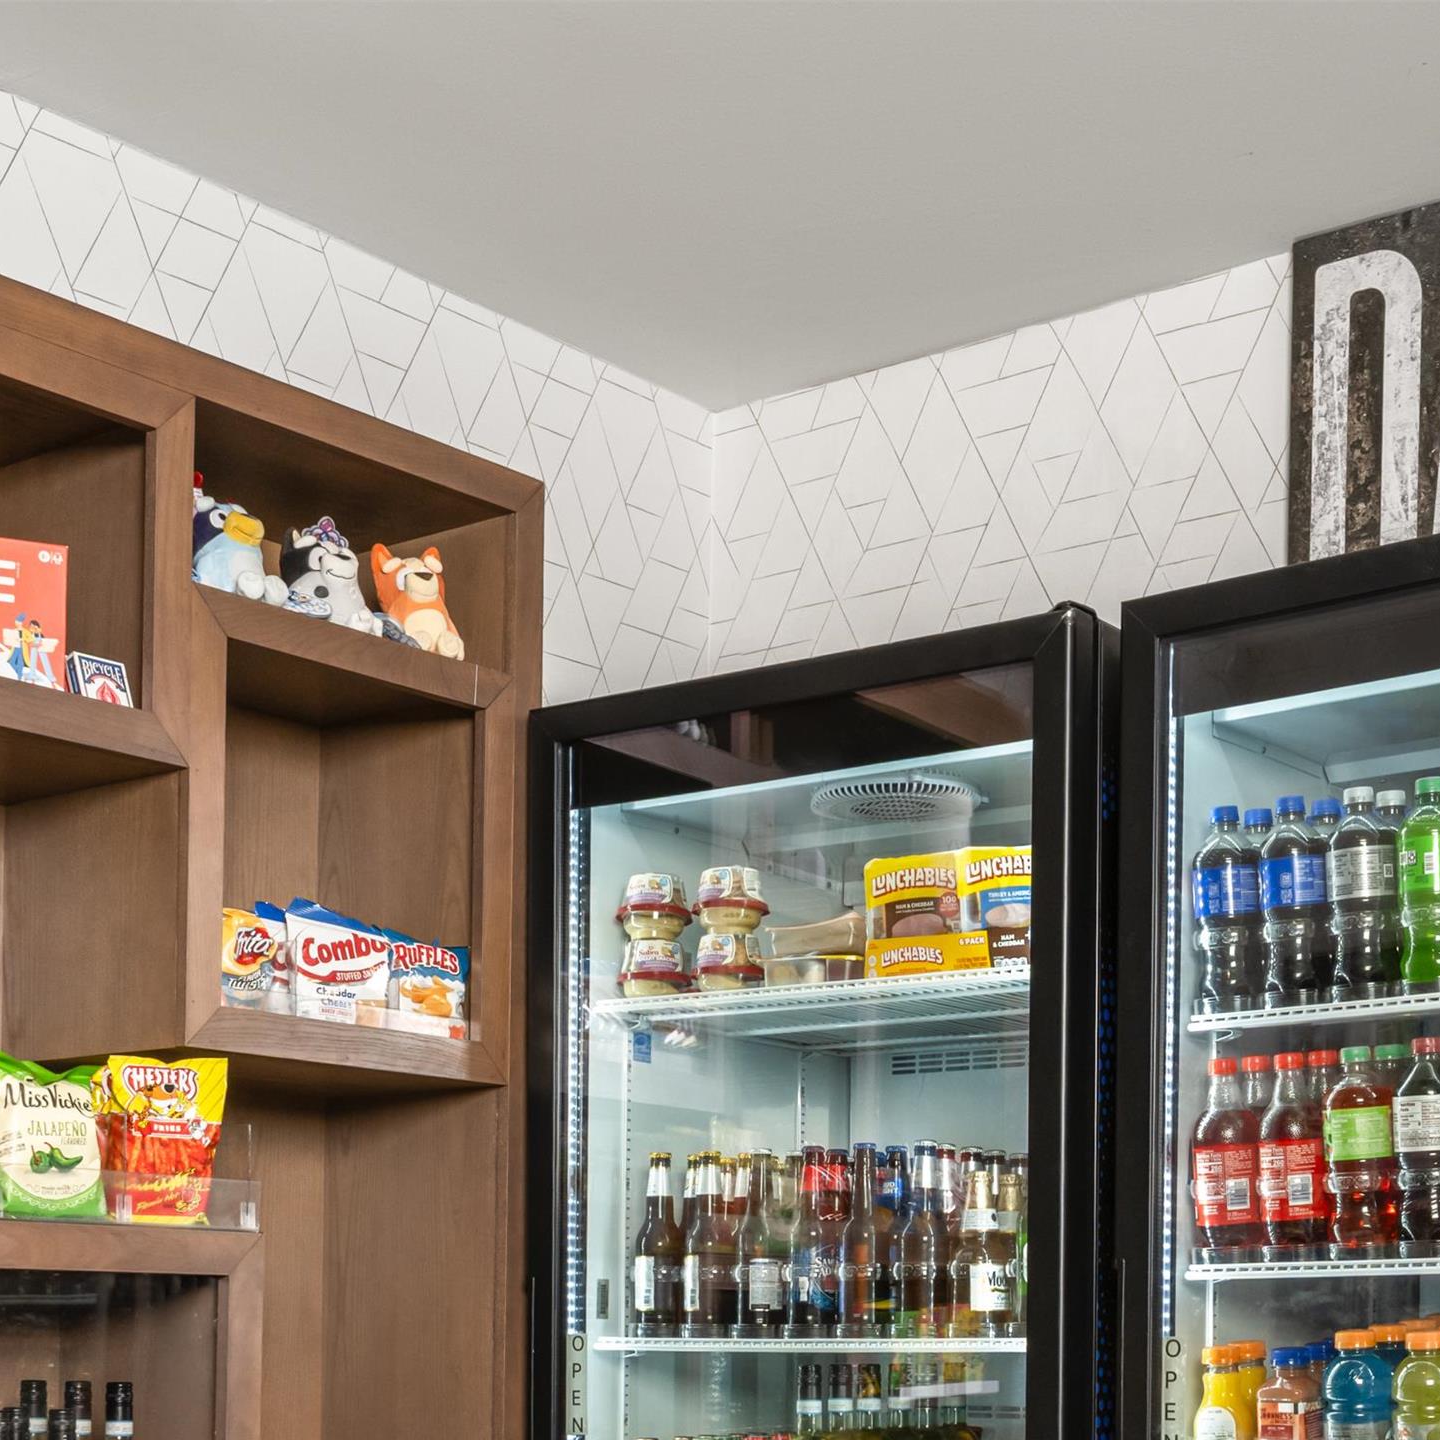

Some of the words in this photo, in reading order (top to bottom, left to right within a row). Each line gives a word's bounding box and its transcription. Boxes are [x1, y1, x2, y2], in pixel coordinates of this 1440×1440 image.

[83, 659, 122, 680] BICYCLE
[872, 868, 956, 897] LUNCHABLES
[997, 939, 1024, 947] CHEDDAR
[391, 944, 458, 972] RUFFLES
[881, 948, 943, 967] LUNCHABLES
[27, 1119, 87, 1136] JALAPEÑO
[572, 1336, 584, 1432] OPEN
